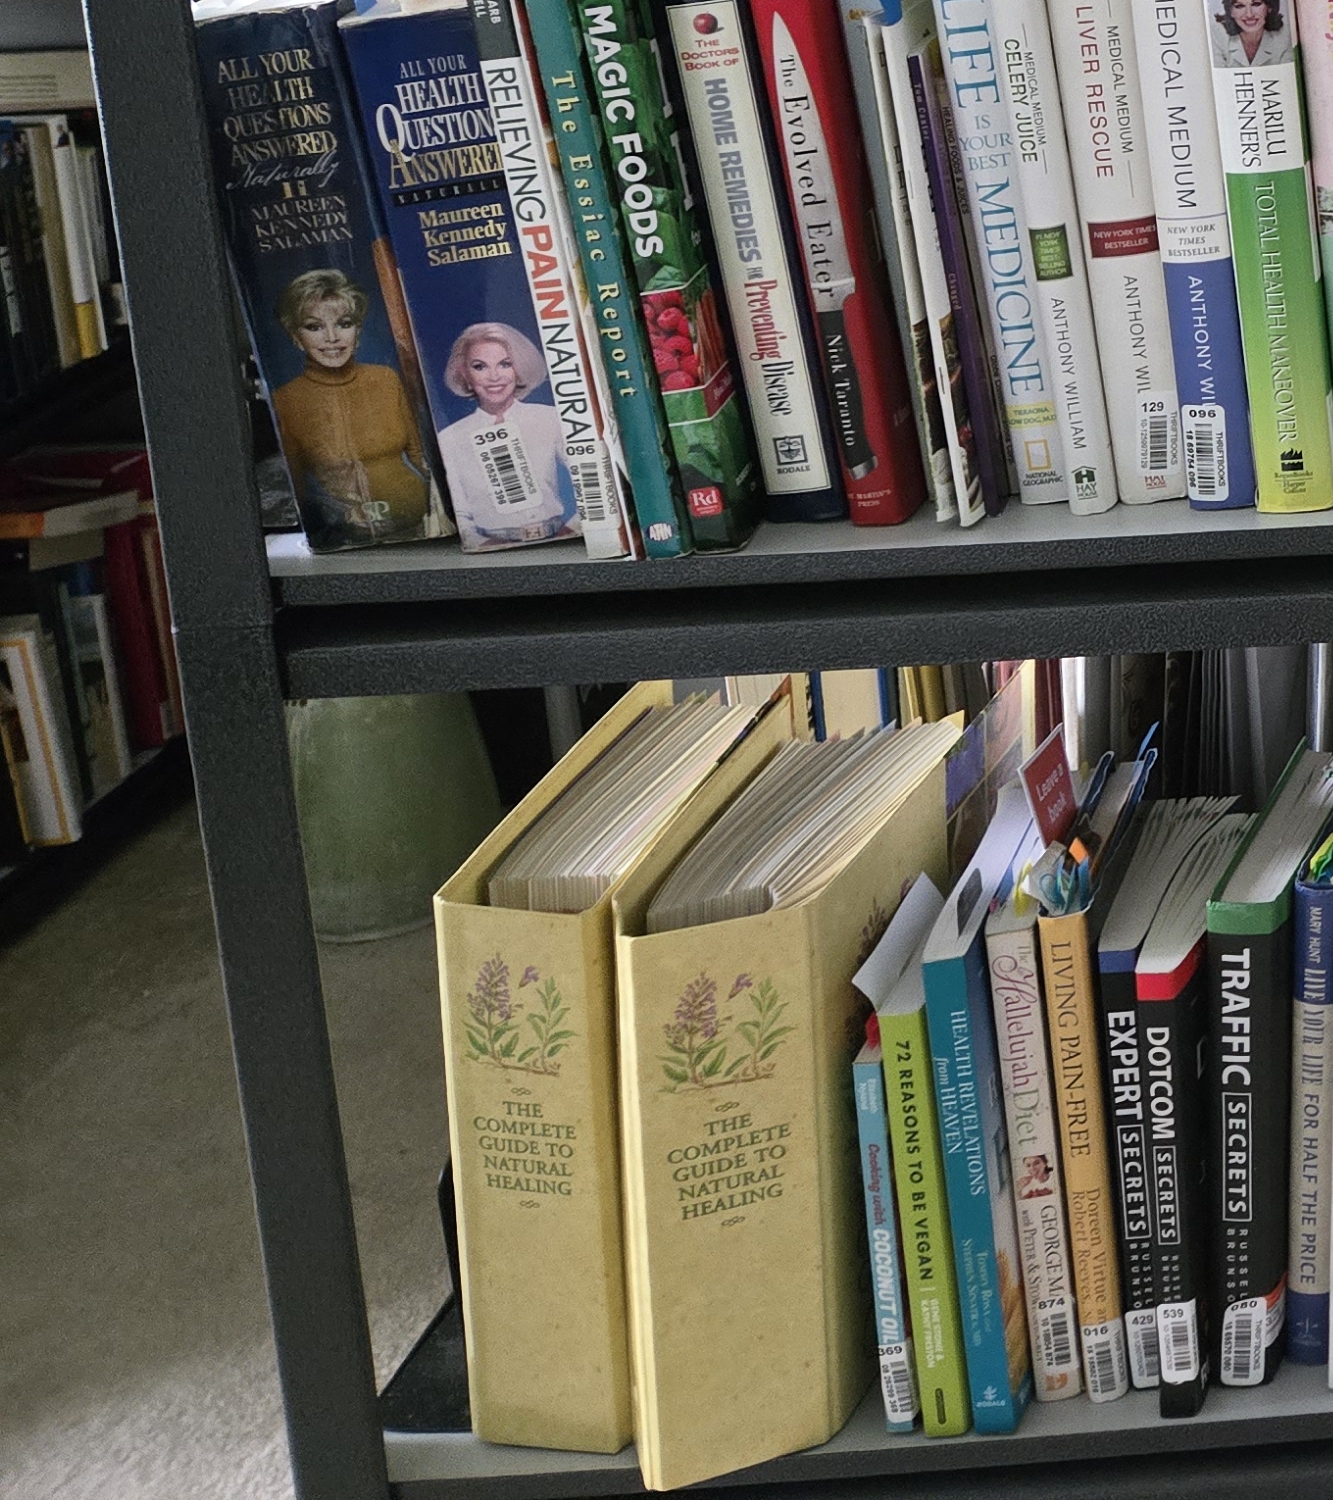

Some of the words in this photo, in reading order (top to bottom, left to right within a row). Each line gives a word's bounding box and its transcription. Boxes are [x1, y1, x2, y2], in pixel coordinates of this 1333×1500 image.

[585, 5, 635, 122] MAGIC
[611, 130, 664, 258] FOODS
[960, 132, 1012, 151] YOUR
[975, 115, 990, 131] IS
[968, 152, 1011, 171] BEST
[1167, 107, 1196, 210] MEDIUM
[486, 64, 549, 221] RELIEVING
[522, 225, 571, 319] PAIN
[419, 203, 504, 229] Maureen
[424, 219, 507, 249] Kennedy
[427, 238, 512, 266] Salaman
[975, 179, 1044, 395] MEDICINE
[1220, 948, 1253, 1087] TRAFFIC
[894, 1039, 911, 1065] 72
[1107, 1008, 1143, 1120] EXPERT
[1146, 1026, 1176, 1139] DOTCOM
[473, 1116, 578, 1140] COMPLETE
[503, 1102, 543, 1118] THE
[703, 1112, 753, 1137] THE
[899, 1070, 921, 1154] REASONS
[478, 1137, 539, 1158] GUIDE
[545, 1141, 574, 1158] TO
[666, 1120, 792, 1166] COMPLETE
[1227, 1100, 1250, 1216] SECRETS
[483, 1156, 574, 1178] NATURAL
[672, 1151, 744, 1184] GUIDE
[751, 1145, 786, 1166] TO
[678, 1164, 785, 1203] NATURAL
[910, 1160, 924, 1185] TO
[1122, 1126, 1148, 1237] SECRETS
[486, 1174, 572, 1197] HEALING
[681, 1183, 784, 1222] HEALING
[912, 1190, 926, 1217] BE
[1156, 1147, 1178, 1243] SECRETS
[915, 1216, 934, 1281] VEGAN
